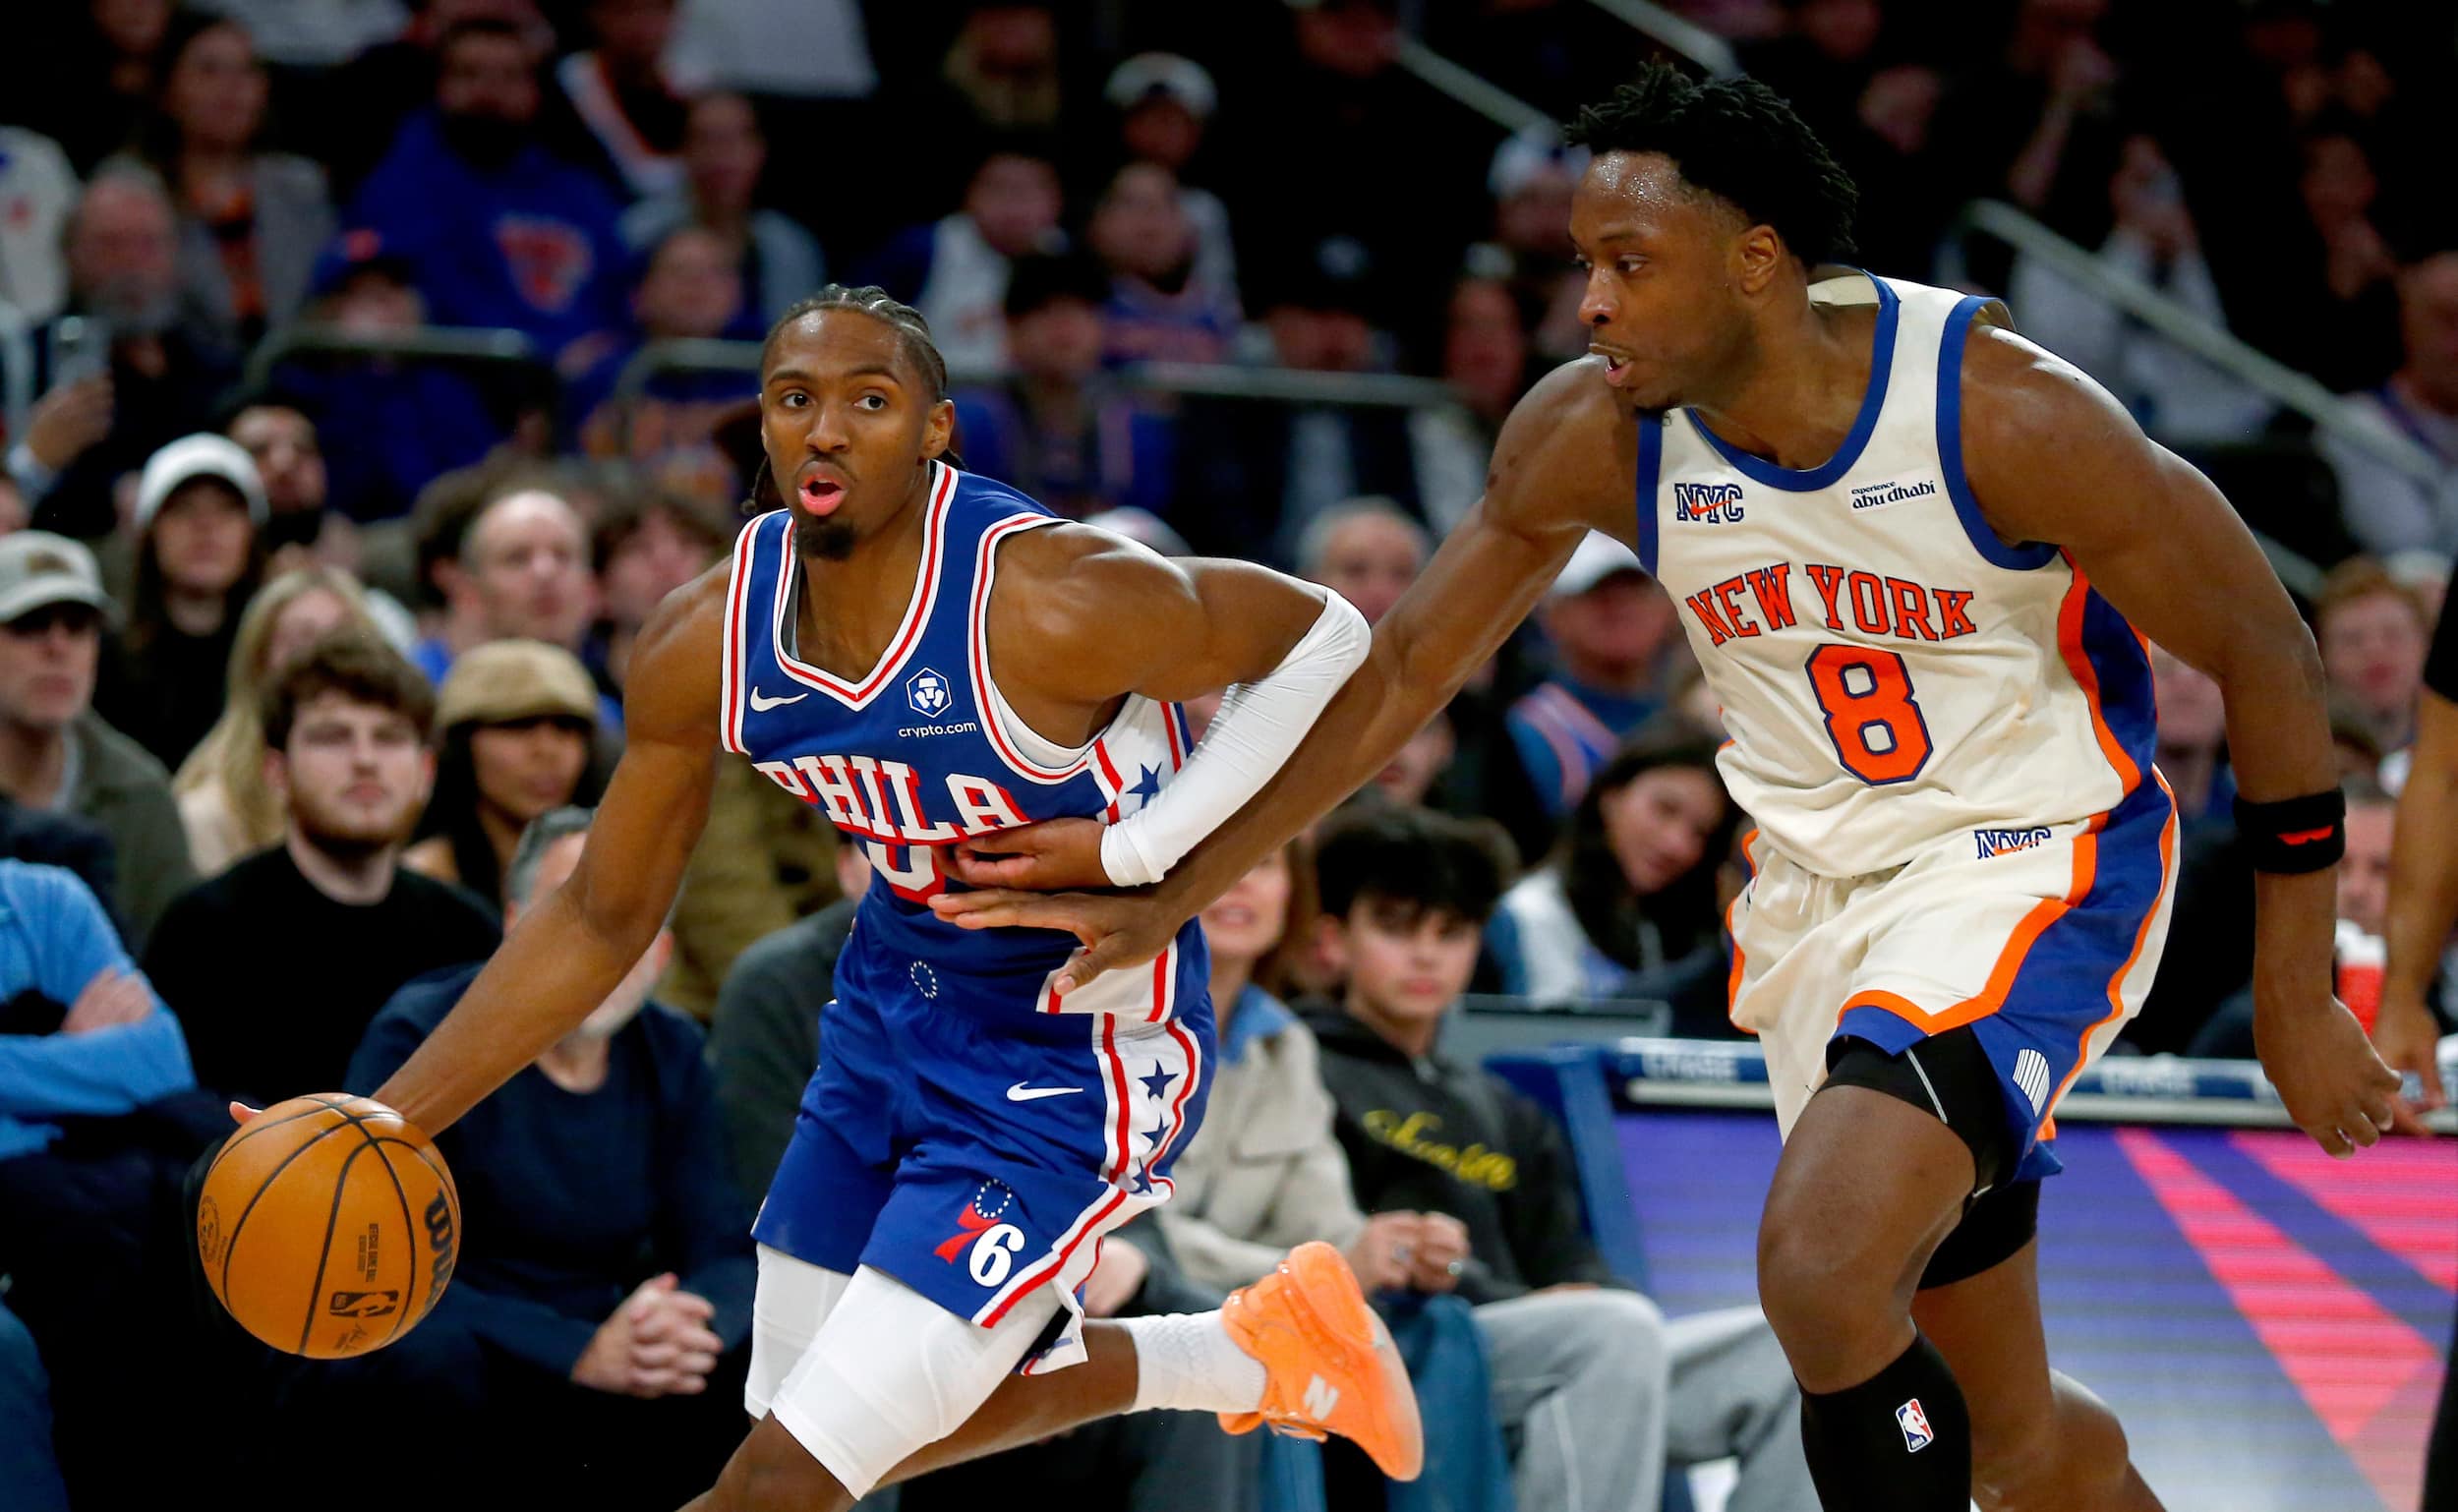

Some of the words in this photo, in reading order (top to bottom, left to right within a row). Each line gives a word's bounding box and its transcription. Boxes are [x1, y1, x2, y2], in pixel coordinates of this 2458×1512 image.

[1674, 483, 1744, 523] NYC
[1850, 481, 1897, 495] experience
[1852, 494, 1886, 509] abu
[1887, 480, 1936, 503] dhabi
[1685, 561, 1797, 647] NEW
[1805, 564, 1977, 642] YORK
[898, 722, 977, 738] crypto.com
[1804, 644, 1934, 785] 8
[752, 754, 1032, 845] PHILA
